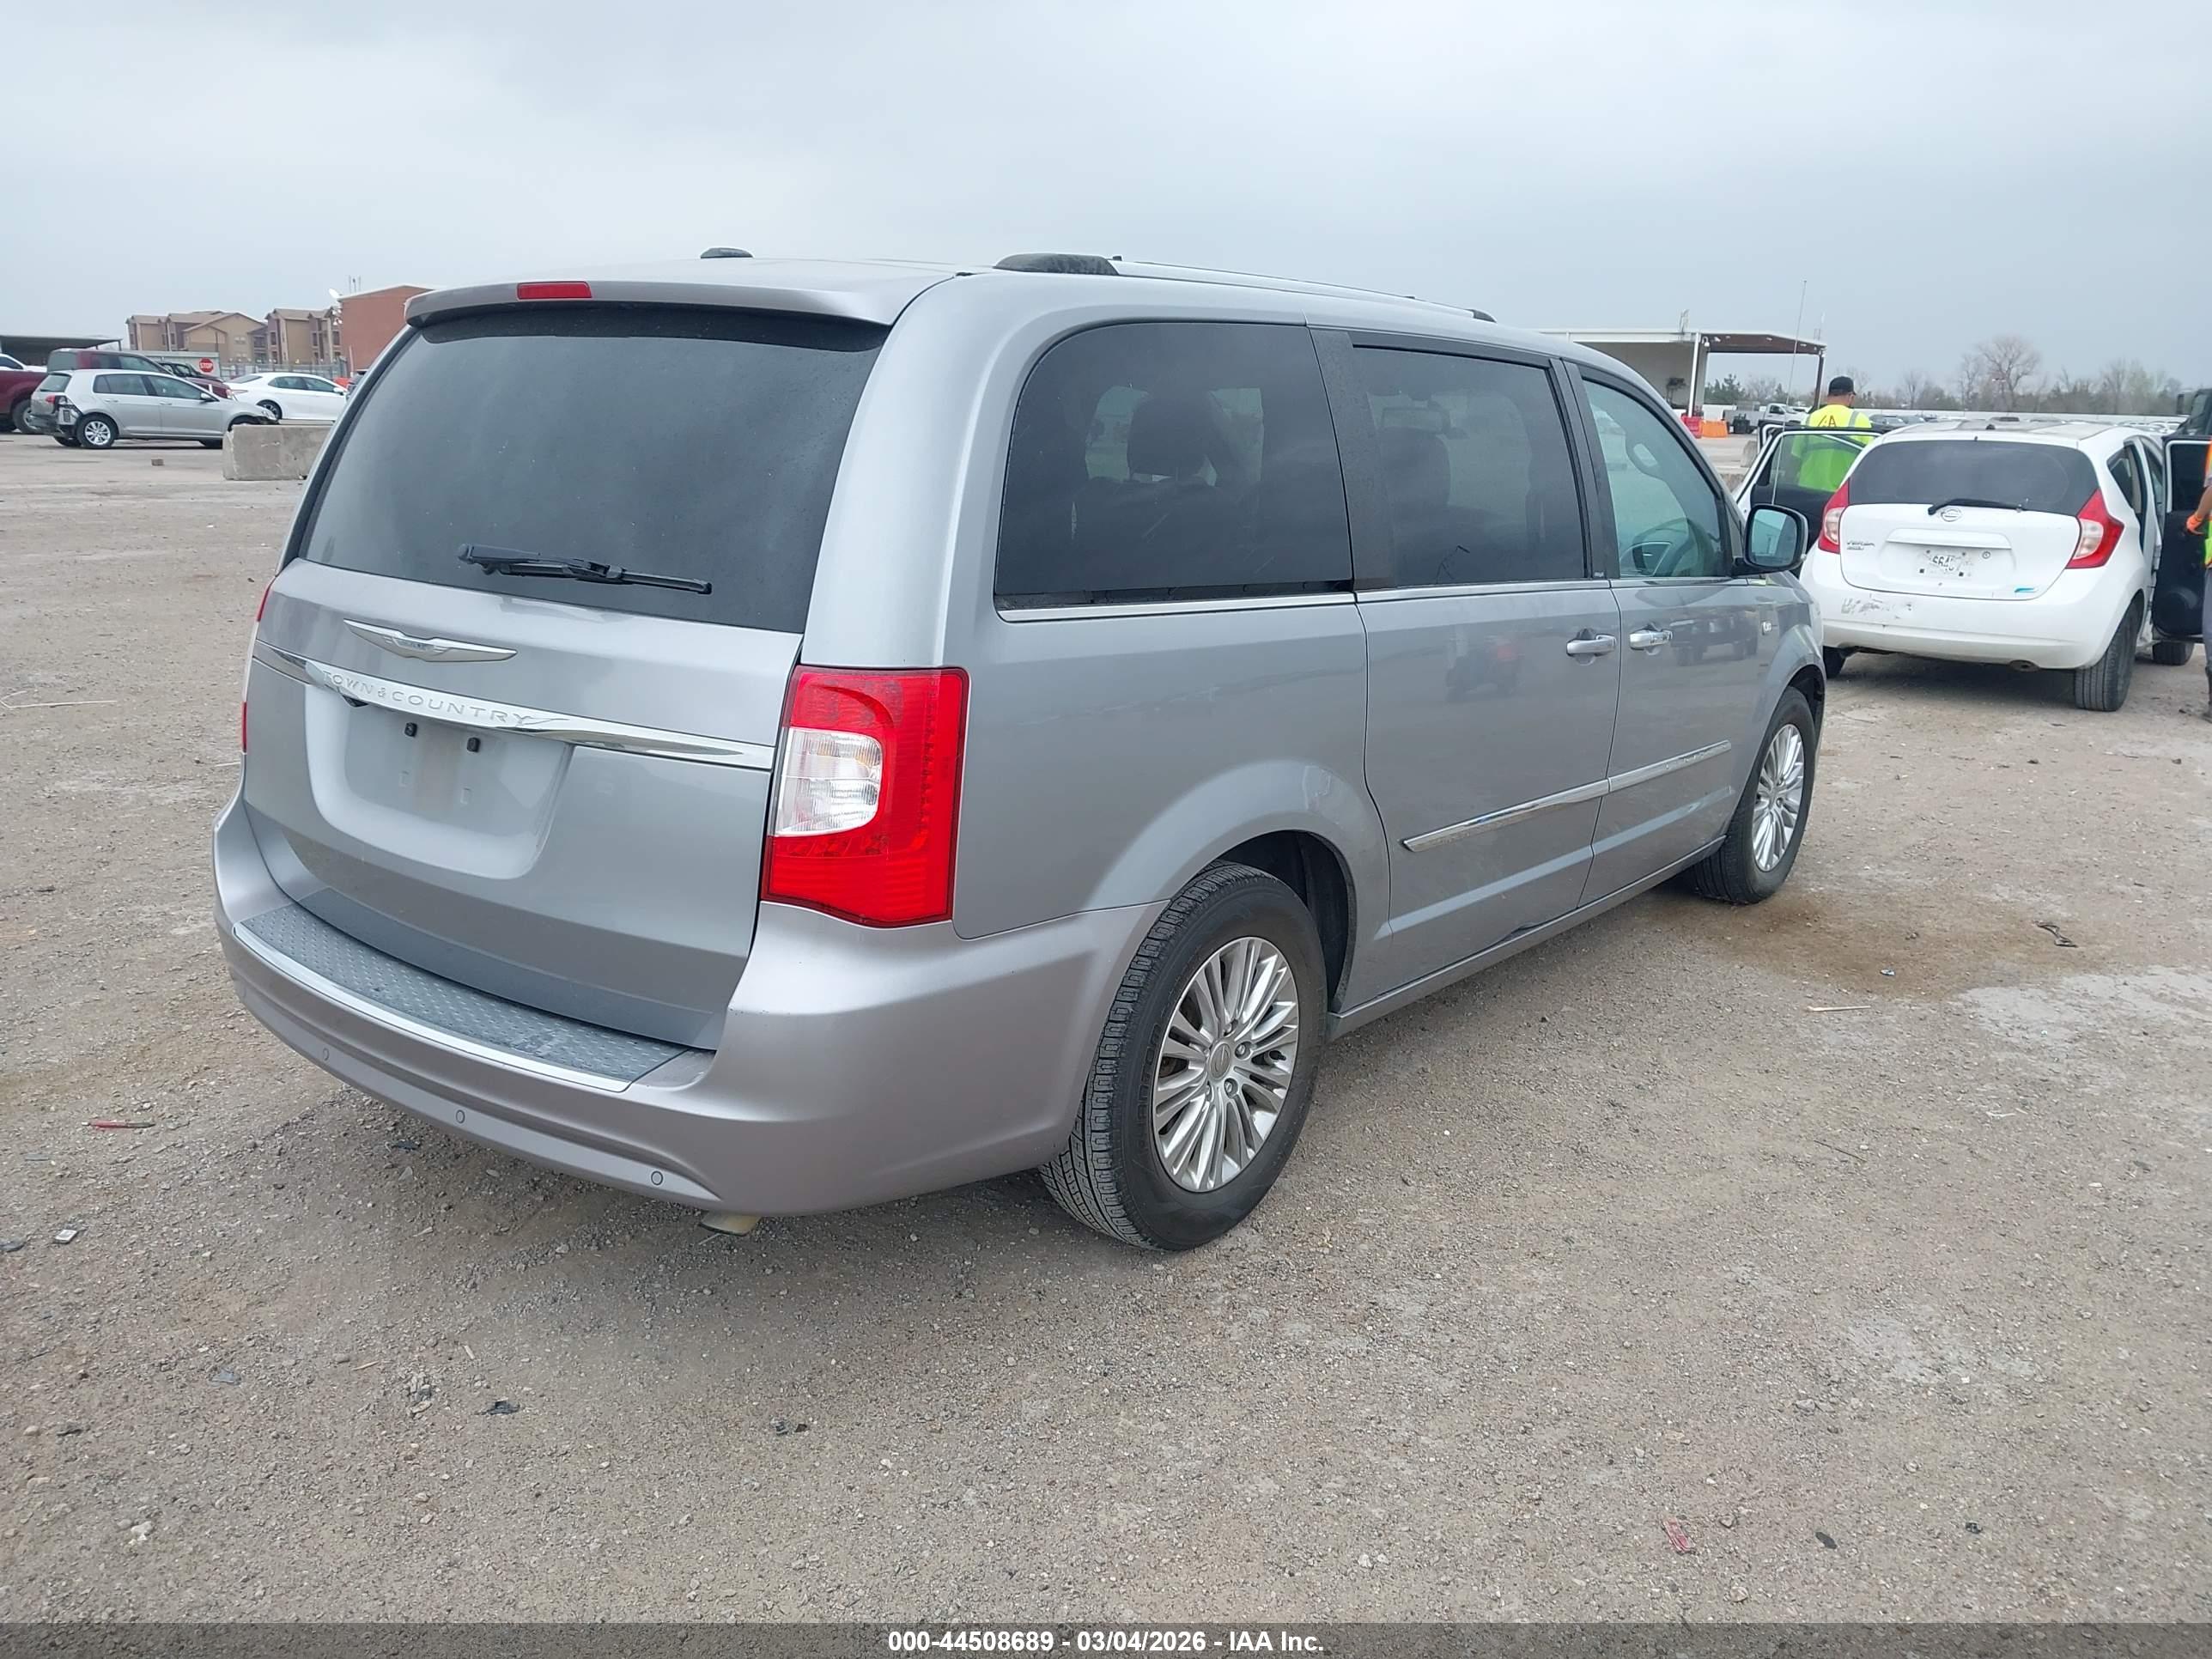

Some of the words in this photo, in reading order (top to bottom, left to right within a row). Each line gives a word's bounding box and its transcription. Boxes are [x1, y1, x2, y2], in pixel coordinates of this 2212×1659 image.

[322, 670, 374, 695] TOWN
[377, 687, 386, 699] &
[392, 690, 534, 727] COUNTRY
